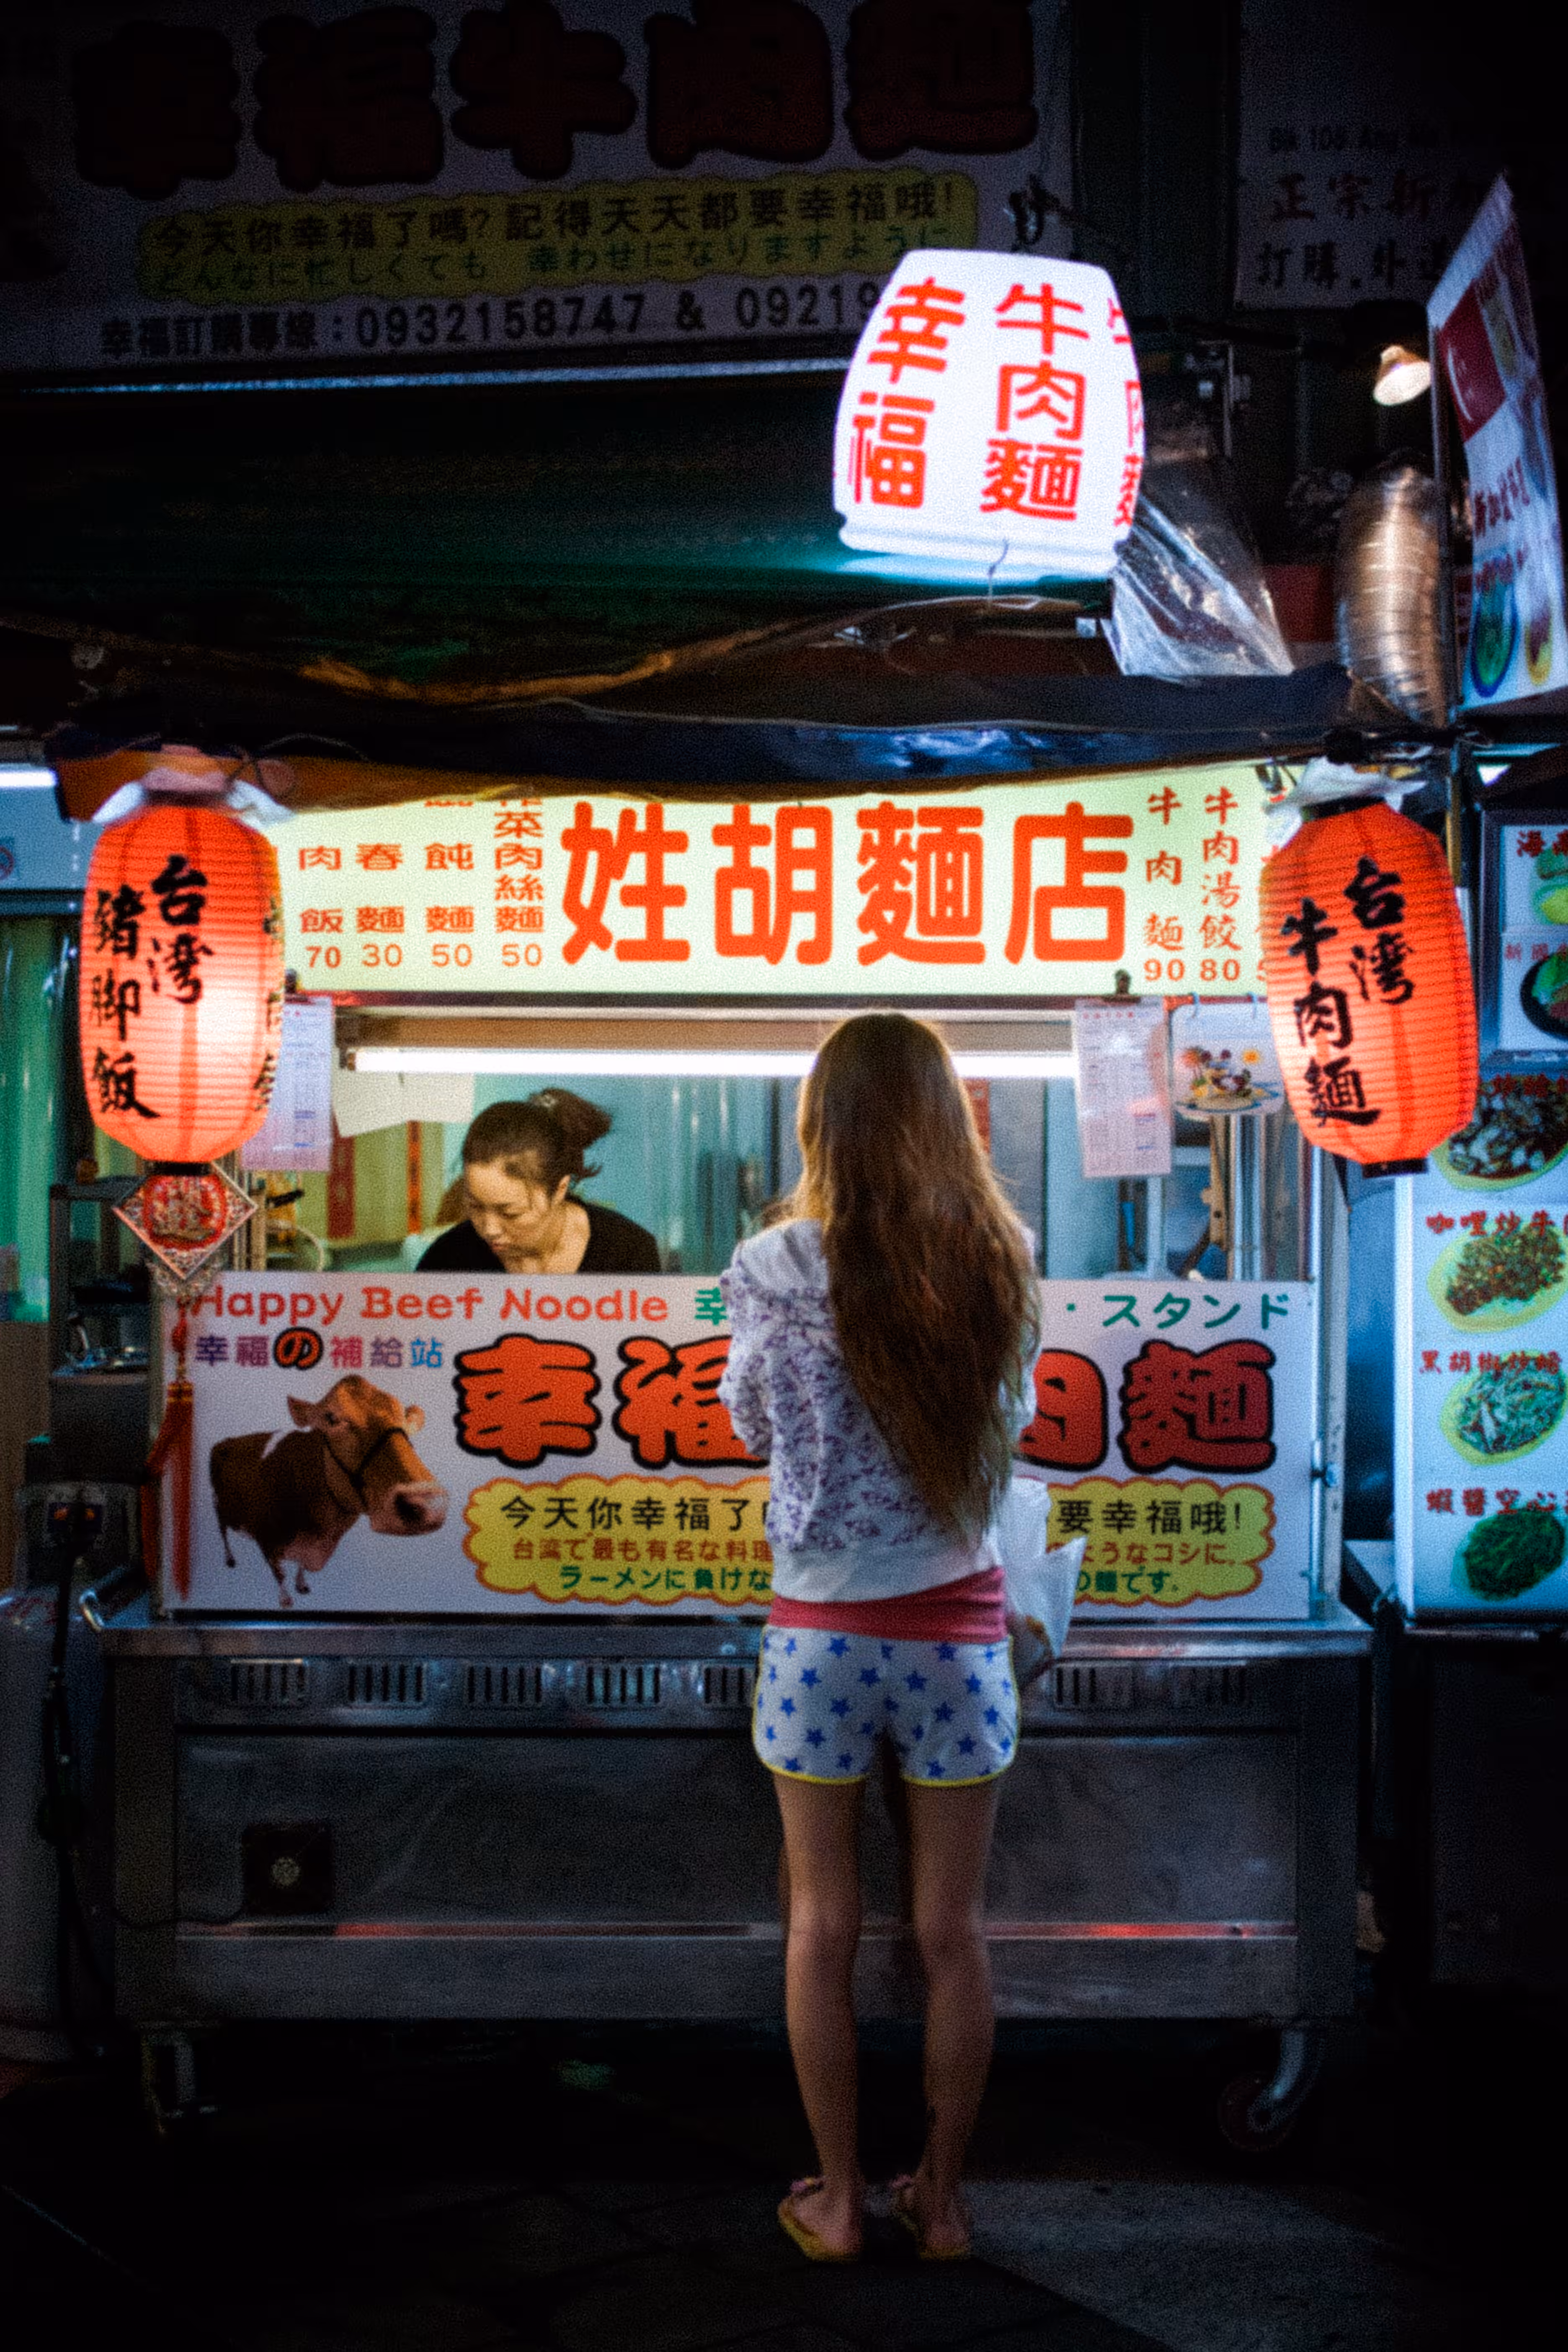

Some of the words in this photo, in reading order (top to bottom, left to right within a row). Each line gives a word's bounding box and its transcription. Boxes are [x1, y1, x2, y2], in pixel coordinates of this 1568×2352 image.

[676, 291, 704, 331] &
[847, 276, 966, 509] 幸福
[979, 283, 1090, 522] 牛肉麵
[147, 854, 215, 1004] 台灣
[561, 800, 1134, 966] 姓胡麵店
[1144, 786, 1184, 951] 牛肉麵
[1199, 785, 1242, 951] 牛肉湯餃
[1344, 854, 1414, 1006] 台灣
[305, 946, 341, 969] 70
[361, 944, 403, 967] 30
[431, 944, 473, 967] 50
[502, 944, 543, 967] 50
[1144, 958, 1185, 982] 90
[1200, 958, 1241, 982] 80
[1280, 895, 1381, 1128] 牛肉麵
[1425, 1209, 1568, 1237] 咖哩炒牛
[194, 1326, 443, 1370] 幸福の補給站
[360, 1286, 484, 1320] Beef
[500, 1287, 669, 1322] Noodle
[452, 1333, 771, 1469] 幸福
[501, 1496, 769, 1531] 今天你幸福了
[1426, 1487, 1568, 1516] 蝦醬空心
